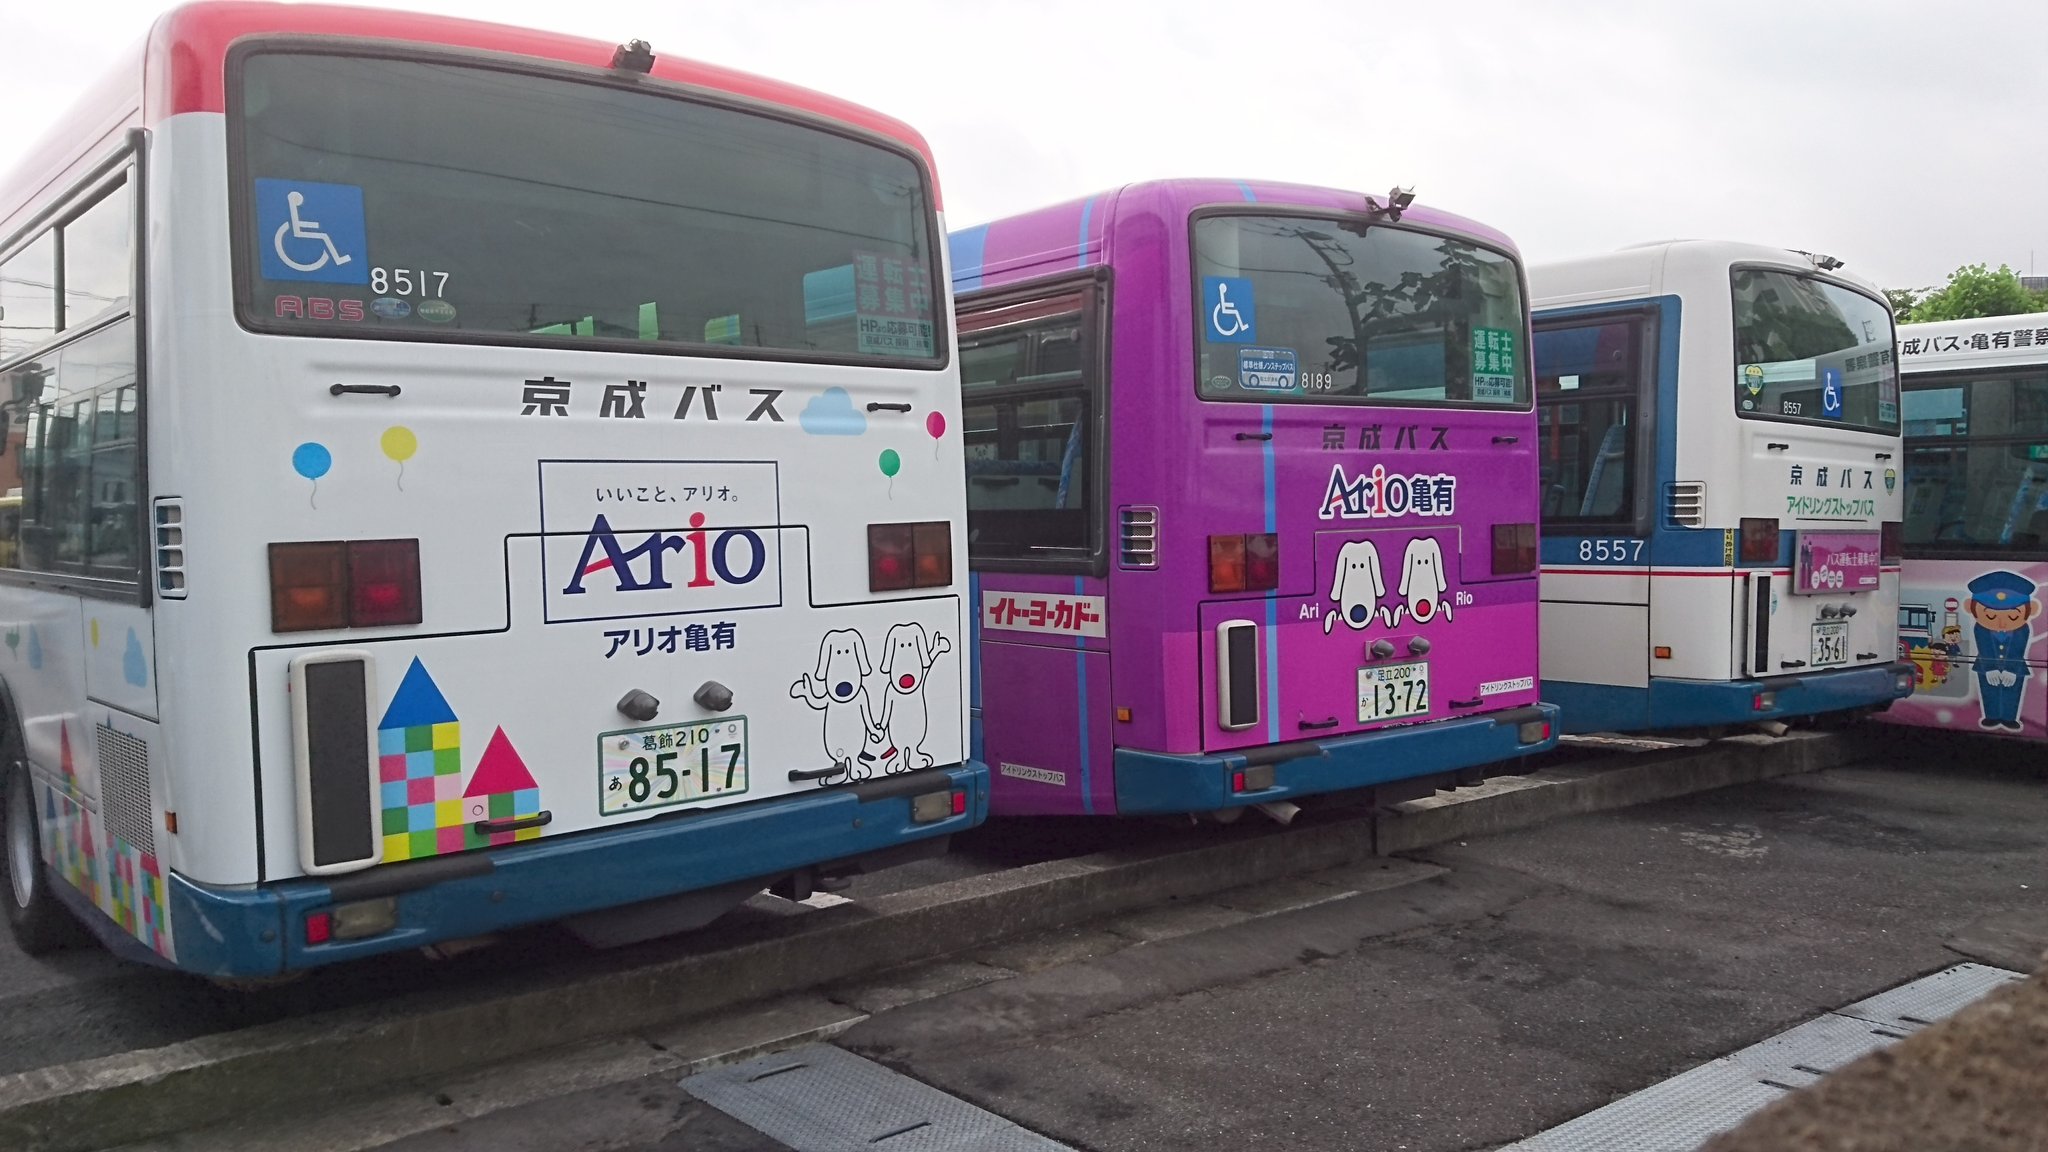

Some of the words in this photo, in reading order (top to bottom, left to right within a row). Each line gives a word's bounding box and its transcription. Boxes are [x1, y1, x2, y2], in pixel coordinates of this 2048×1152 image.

[371, 267, 449, 297] 8517
[275, 295, 364, 321] ABS
[1474, 330, 1512, 351] 運転士
[1898, 328, 2048, 356] 成バス・亀有警察
[1474, 350, 1512, 372] 募集中
[1301, 372, 1332, 389] 8189
[520, 377, 784, 422] 京成バス
[1783, 401, 1801, 415] 8557
[1322, 423, 1449, 450] 京成バス
[1791, 464, 1872, 489] 京成バス
[596, 486, 738, 502] いいこと、アリオ。
[1787, 496, 1874, 516] アイドリングストップバス
[563, 511, 766, 595] Ario
[1580, 540, 1644, 561] 8557
[1456, 591, 1473, 605] Rio
[989, 597, 1099, 630] イトーヨーカドー
[1300, 603, 1319, 619] Ari
[603, 621, 737, 659] アリオ亀有
[1374, 679, 1426, 716] 13-72
[1481, 678, 1532, 694] アイドリングストップバス
[609, 776, 622, 791] あ
[629, 743, 741, 803] 85-17
[1001, 764, 1064, 783] アイドリングストップバス
